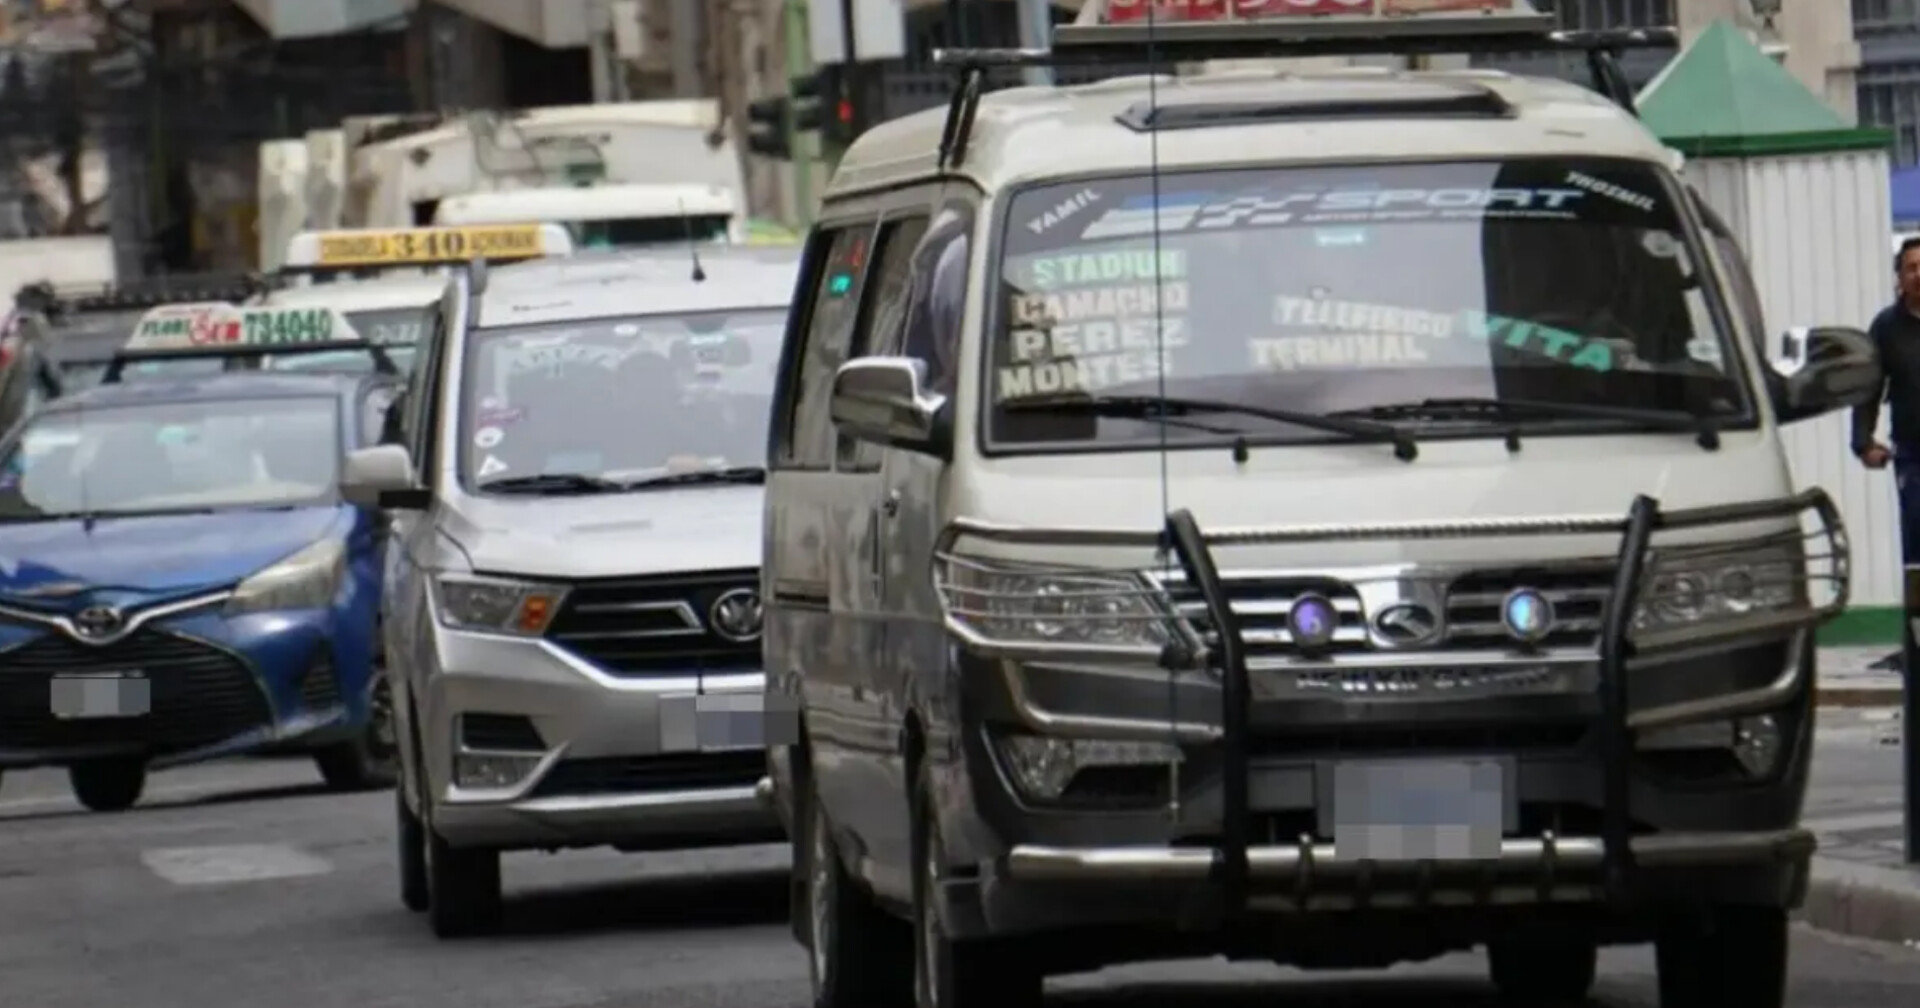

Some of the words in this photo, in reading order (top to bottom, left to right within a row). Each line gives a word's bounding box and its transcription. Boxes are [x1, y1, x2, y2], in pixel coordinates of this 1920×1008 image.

[1026, 188, 1101, 235] YAMIL
[1314, 186, 1585, 209] SPORT
[393, 233, 464, 256] 340
[244, 307, 334, 344] 734040
[1013, 317, 1187, 363] PEREZ
[1464, 307, 1615, 373] VITA
[1000, 351, 1174, 398] MONTES
